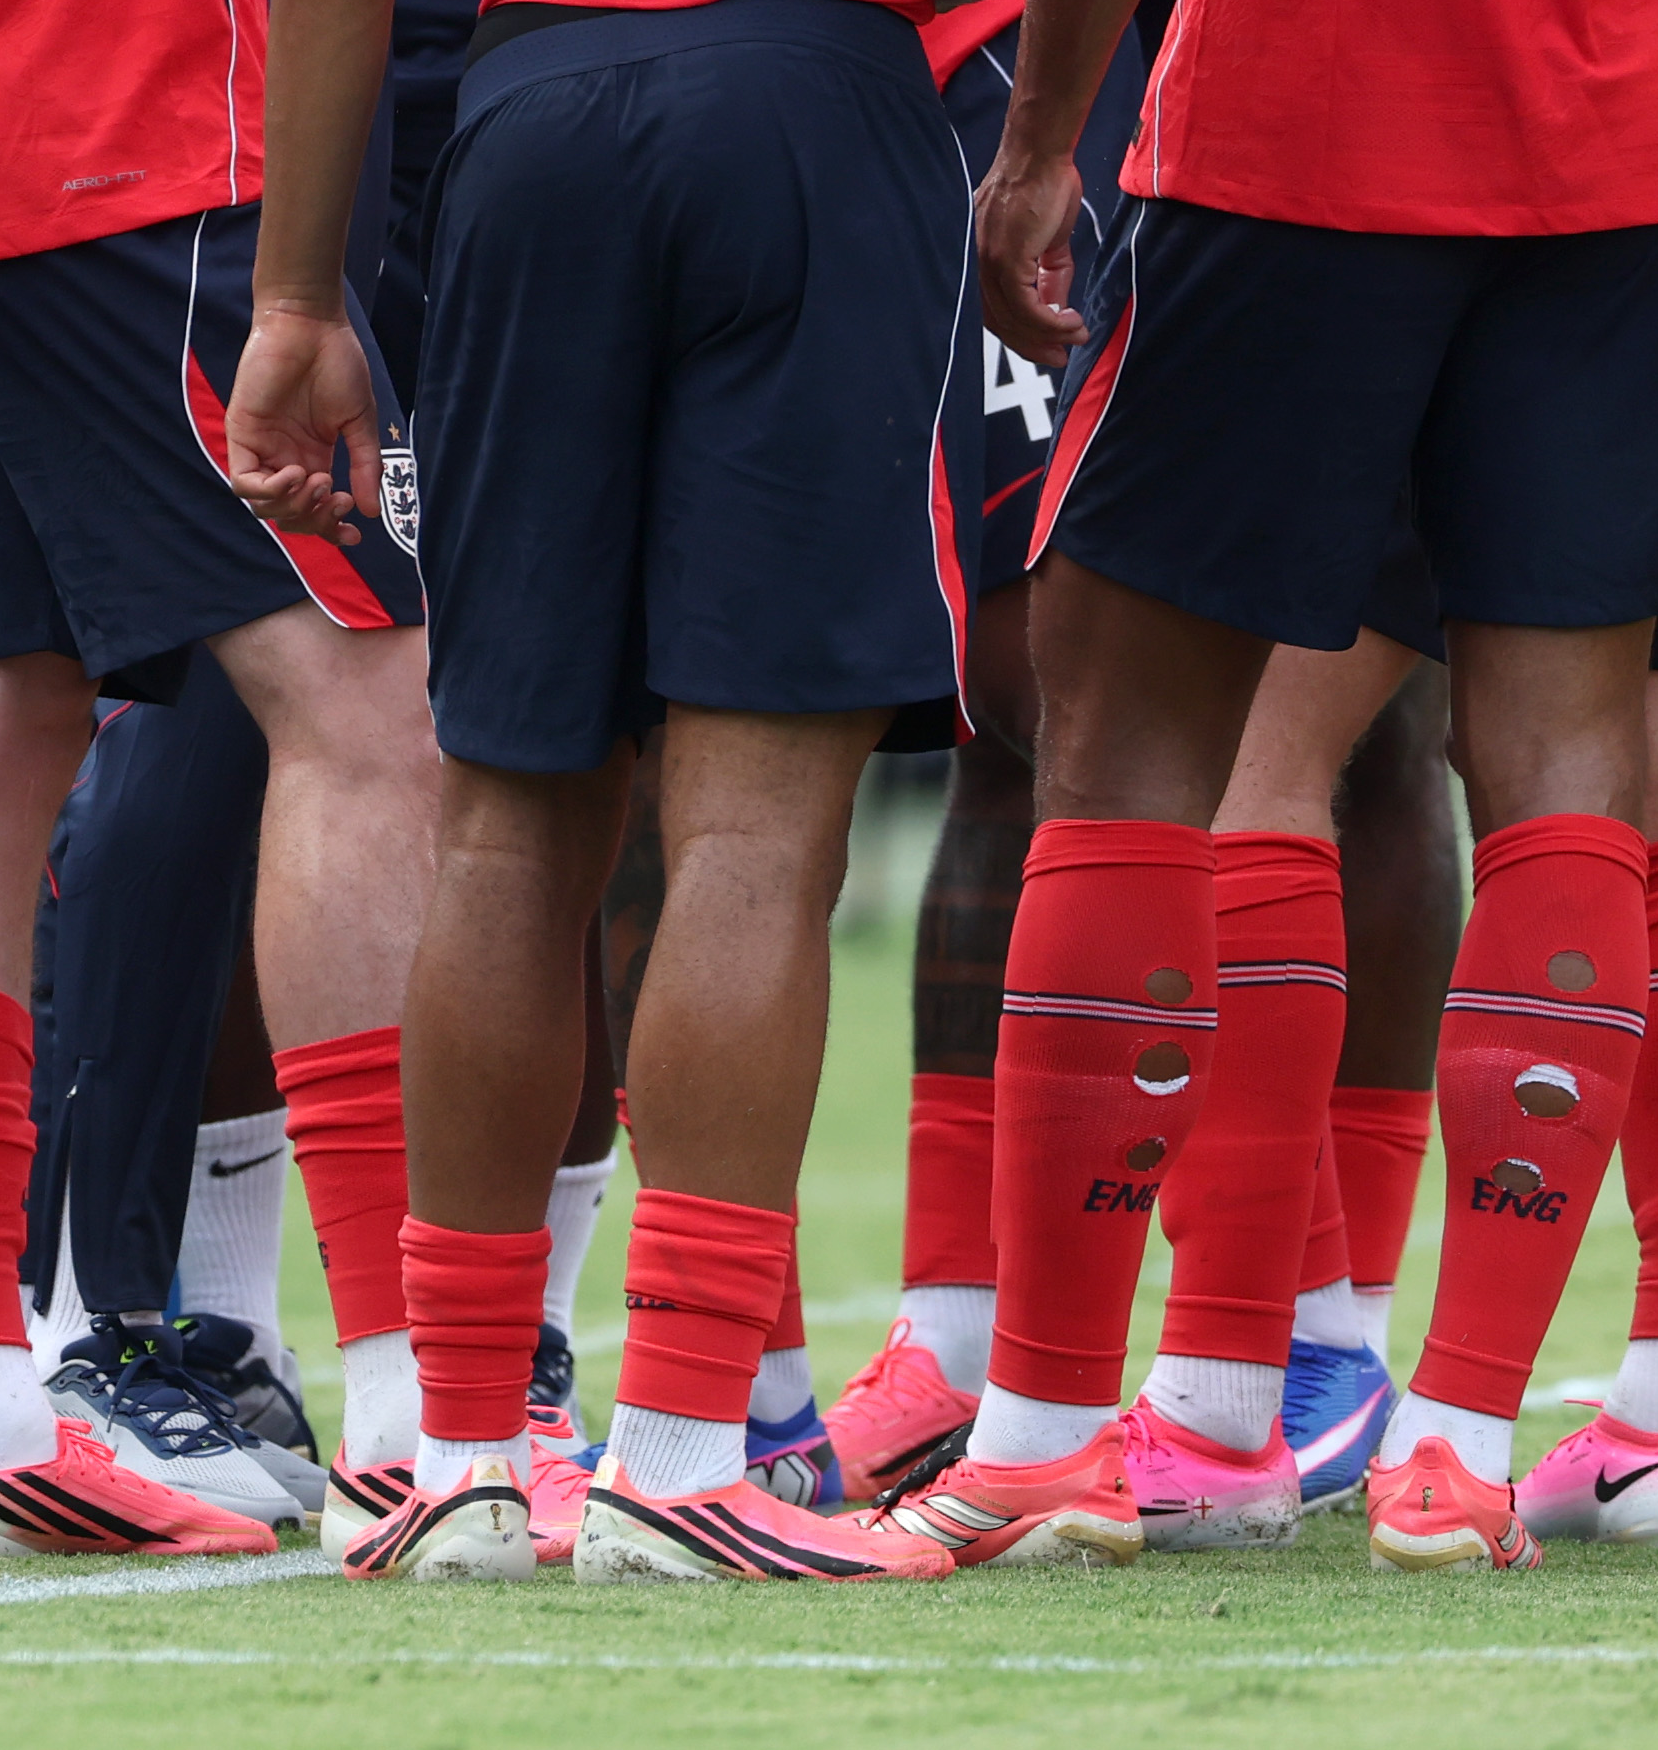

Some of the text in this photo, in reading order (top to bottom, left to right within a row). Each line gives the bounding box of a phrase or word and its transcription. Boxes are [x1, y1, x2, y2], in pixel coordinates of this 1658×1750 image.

[62, 169, 147, 192] AERO-FIT
[1084, 1178, 1156, 1213] ENG
[1470, 1177, 1568, 1225] ENG
